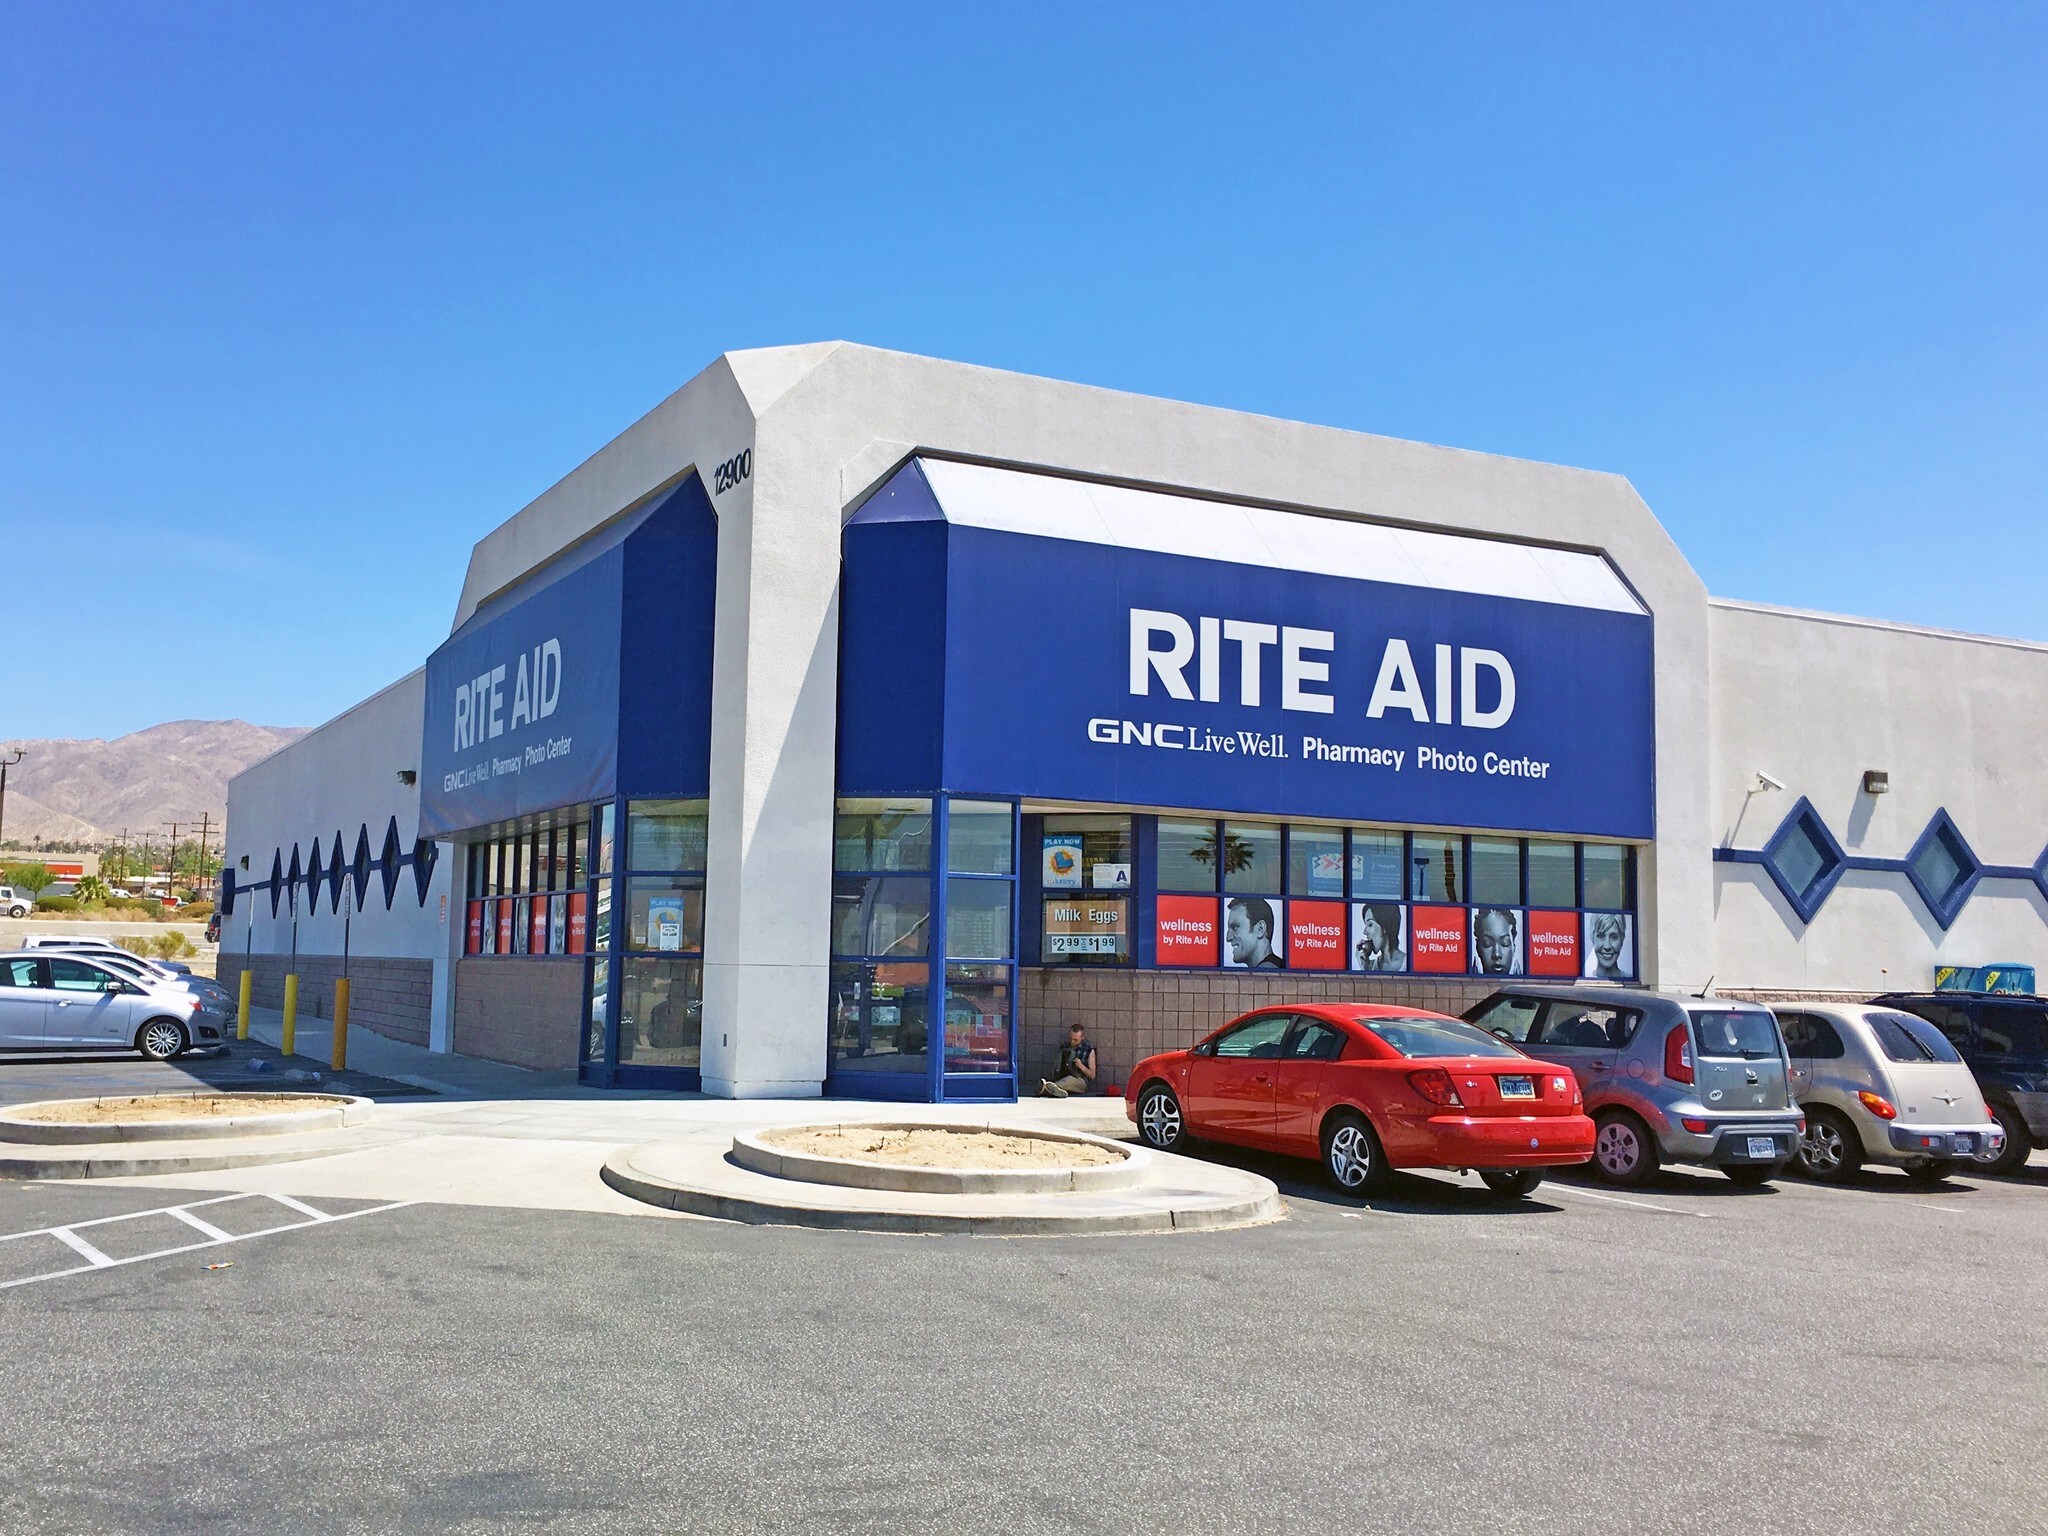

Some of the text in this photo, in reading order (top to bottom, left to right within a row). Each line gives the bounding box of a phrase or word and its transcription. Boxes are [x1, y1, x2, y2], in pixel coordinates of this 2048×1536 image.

[714, 448, 751, 496] 12900
[1130, 608, 1516, 729] RITE AID
[454, 637, 562, 752] RITE AID
[1087, 718, 1184, 749] GNC
[1303, 736, 1405, 772] Pharmacy
[1417, 746, 1478, 773] Photo
[1483, 752, 1550, 779] Center
[444, 770, 465, 792] GNC
[492, 756, 522, 775] Pharmacy
[525, 744, 545, 767] Photo
[547, 736, 572, 759] Center
[1115, 870, 1127, 882] A
[1054, 908, 1118, 924] Milk Eggs
[1160, 919, 1212, 932] wellness
[1292, 923, 1341, 936] wellness
[1163, 935, 1208, 945] by Rite Aid
[1416, 928, 1461, 940] wellness
[1532, 932, 1574, 944] wellness
[1295, 939, 1304, 948] by
[1307, 940, 1322, 948] Rite
[1418, 943, 1458, 953] by Rite Aid
[1534, 947, 1572, 956] by Rite Aid
